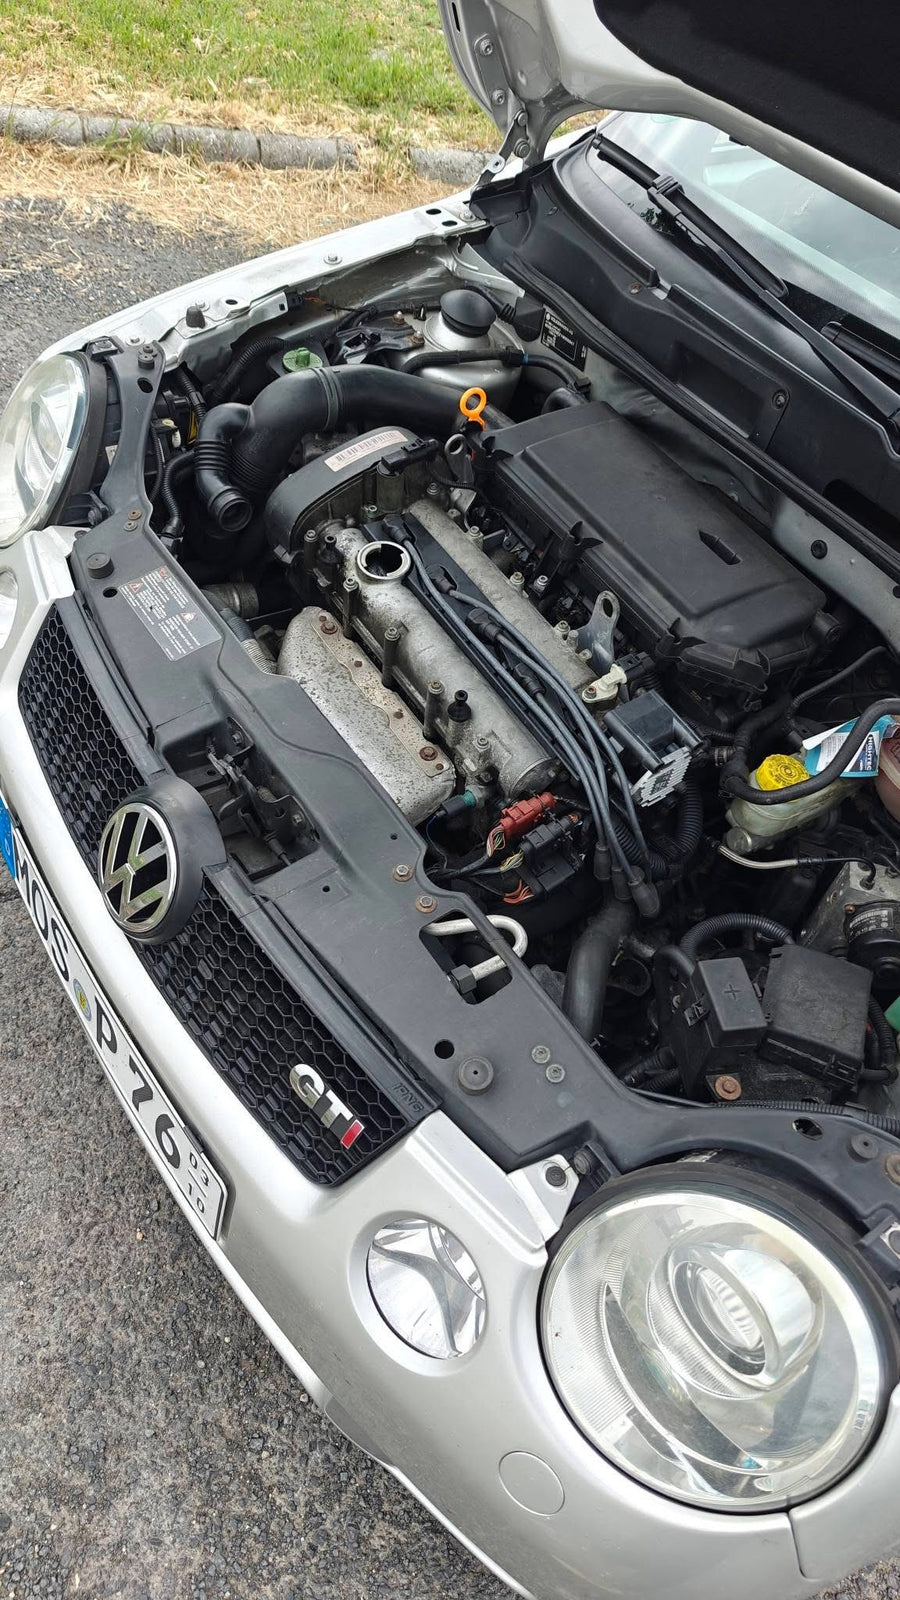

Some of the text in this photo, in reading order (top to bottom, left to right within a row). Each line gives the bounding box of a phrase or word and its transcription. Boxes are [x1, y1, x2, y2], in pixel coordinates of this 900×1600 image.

[13, 833, 181, 1169] MOS P 76
[289, 1063, 365, 1149] GTI
[187, 1182, 205, 1214] 10
[189, 1151, 210, 1187] 03
